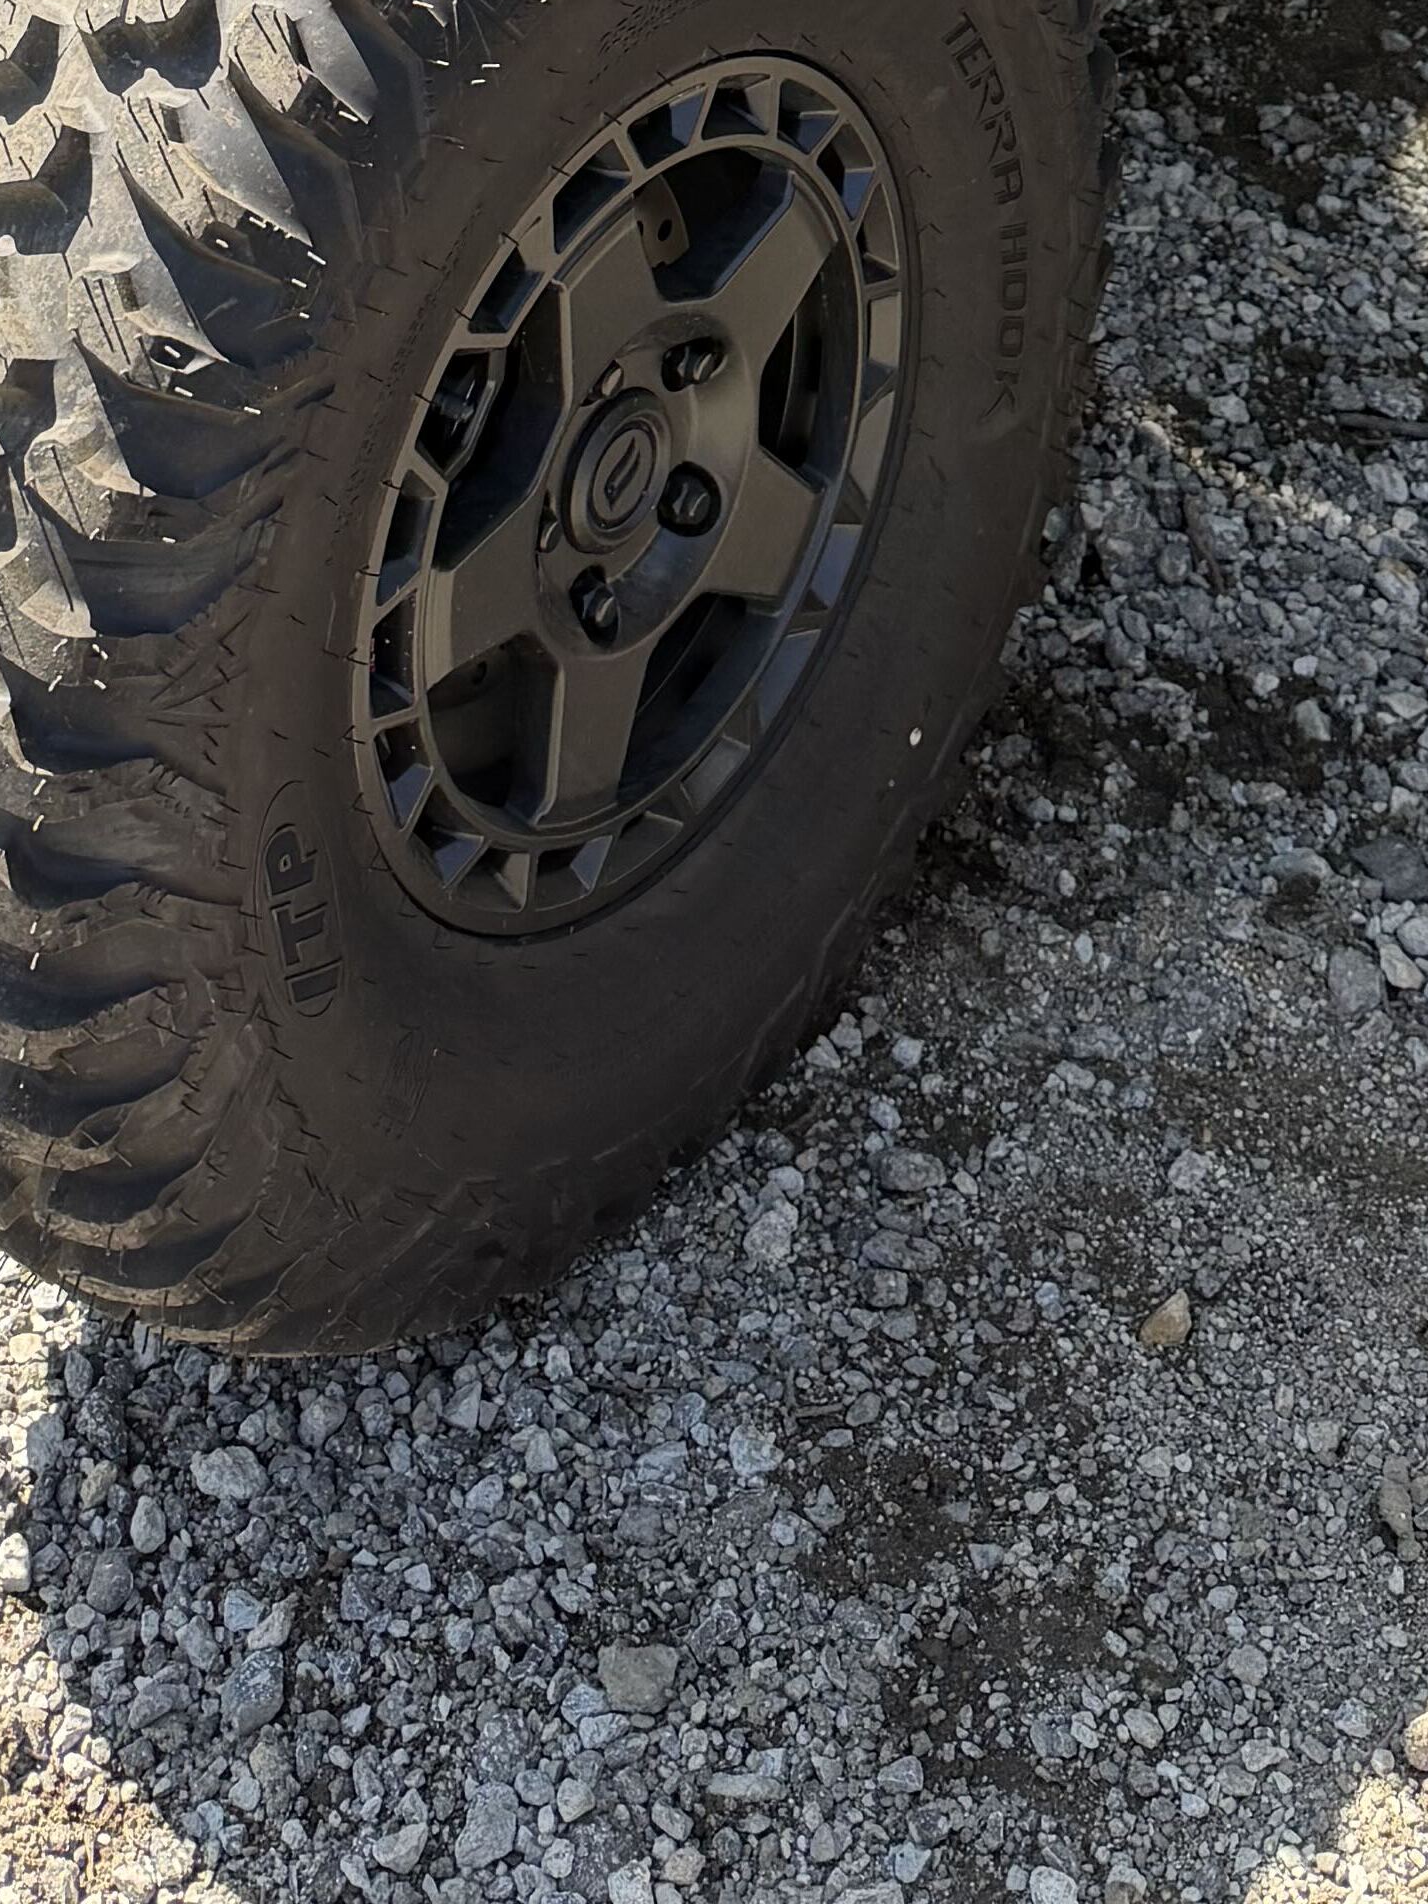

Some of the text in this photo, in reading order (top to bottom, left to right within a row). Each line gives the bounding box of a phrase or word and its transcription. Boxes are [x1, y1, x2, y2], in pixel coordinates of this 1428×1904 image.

[941, 10, 1029, 429] TERRA HOOK
[264, 822, 344, 1018] ITP
